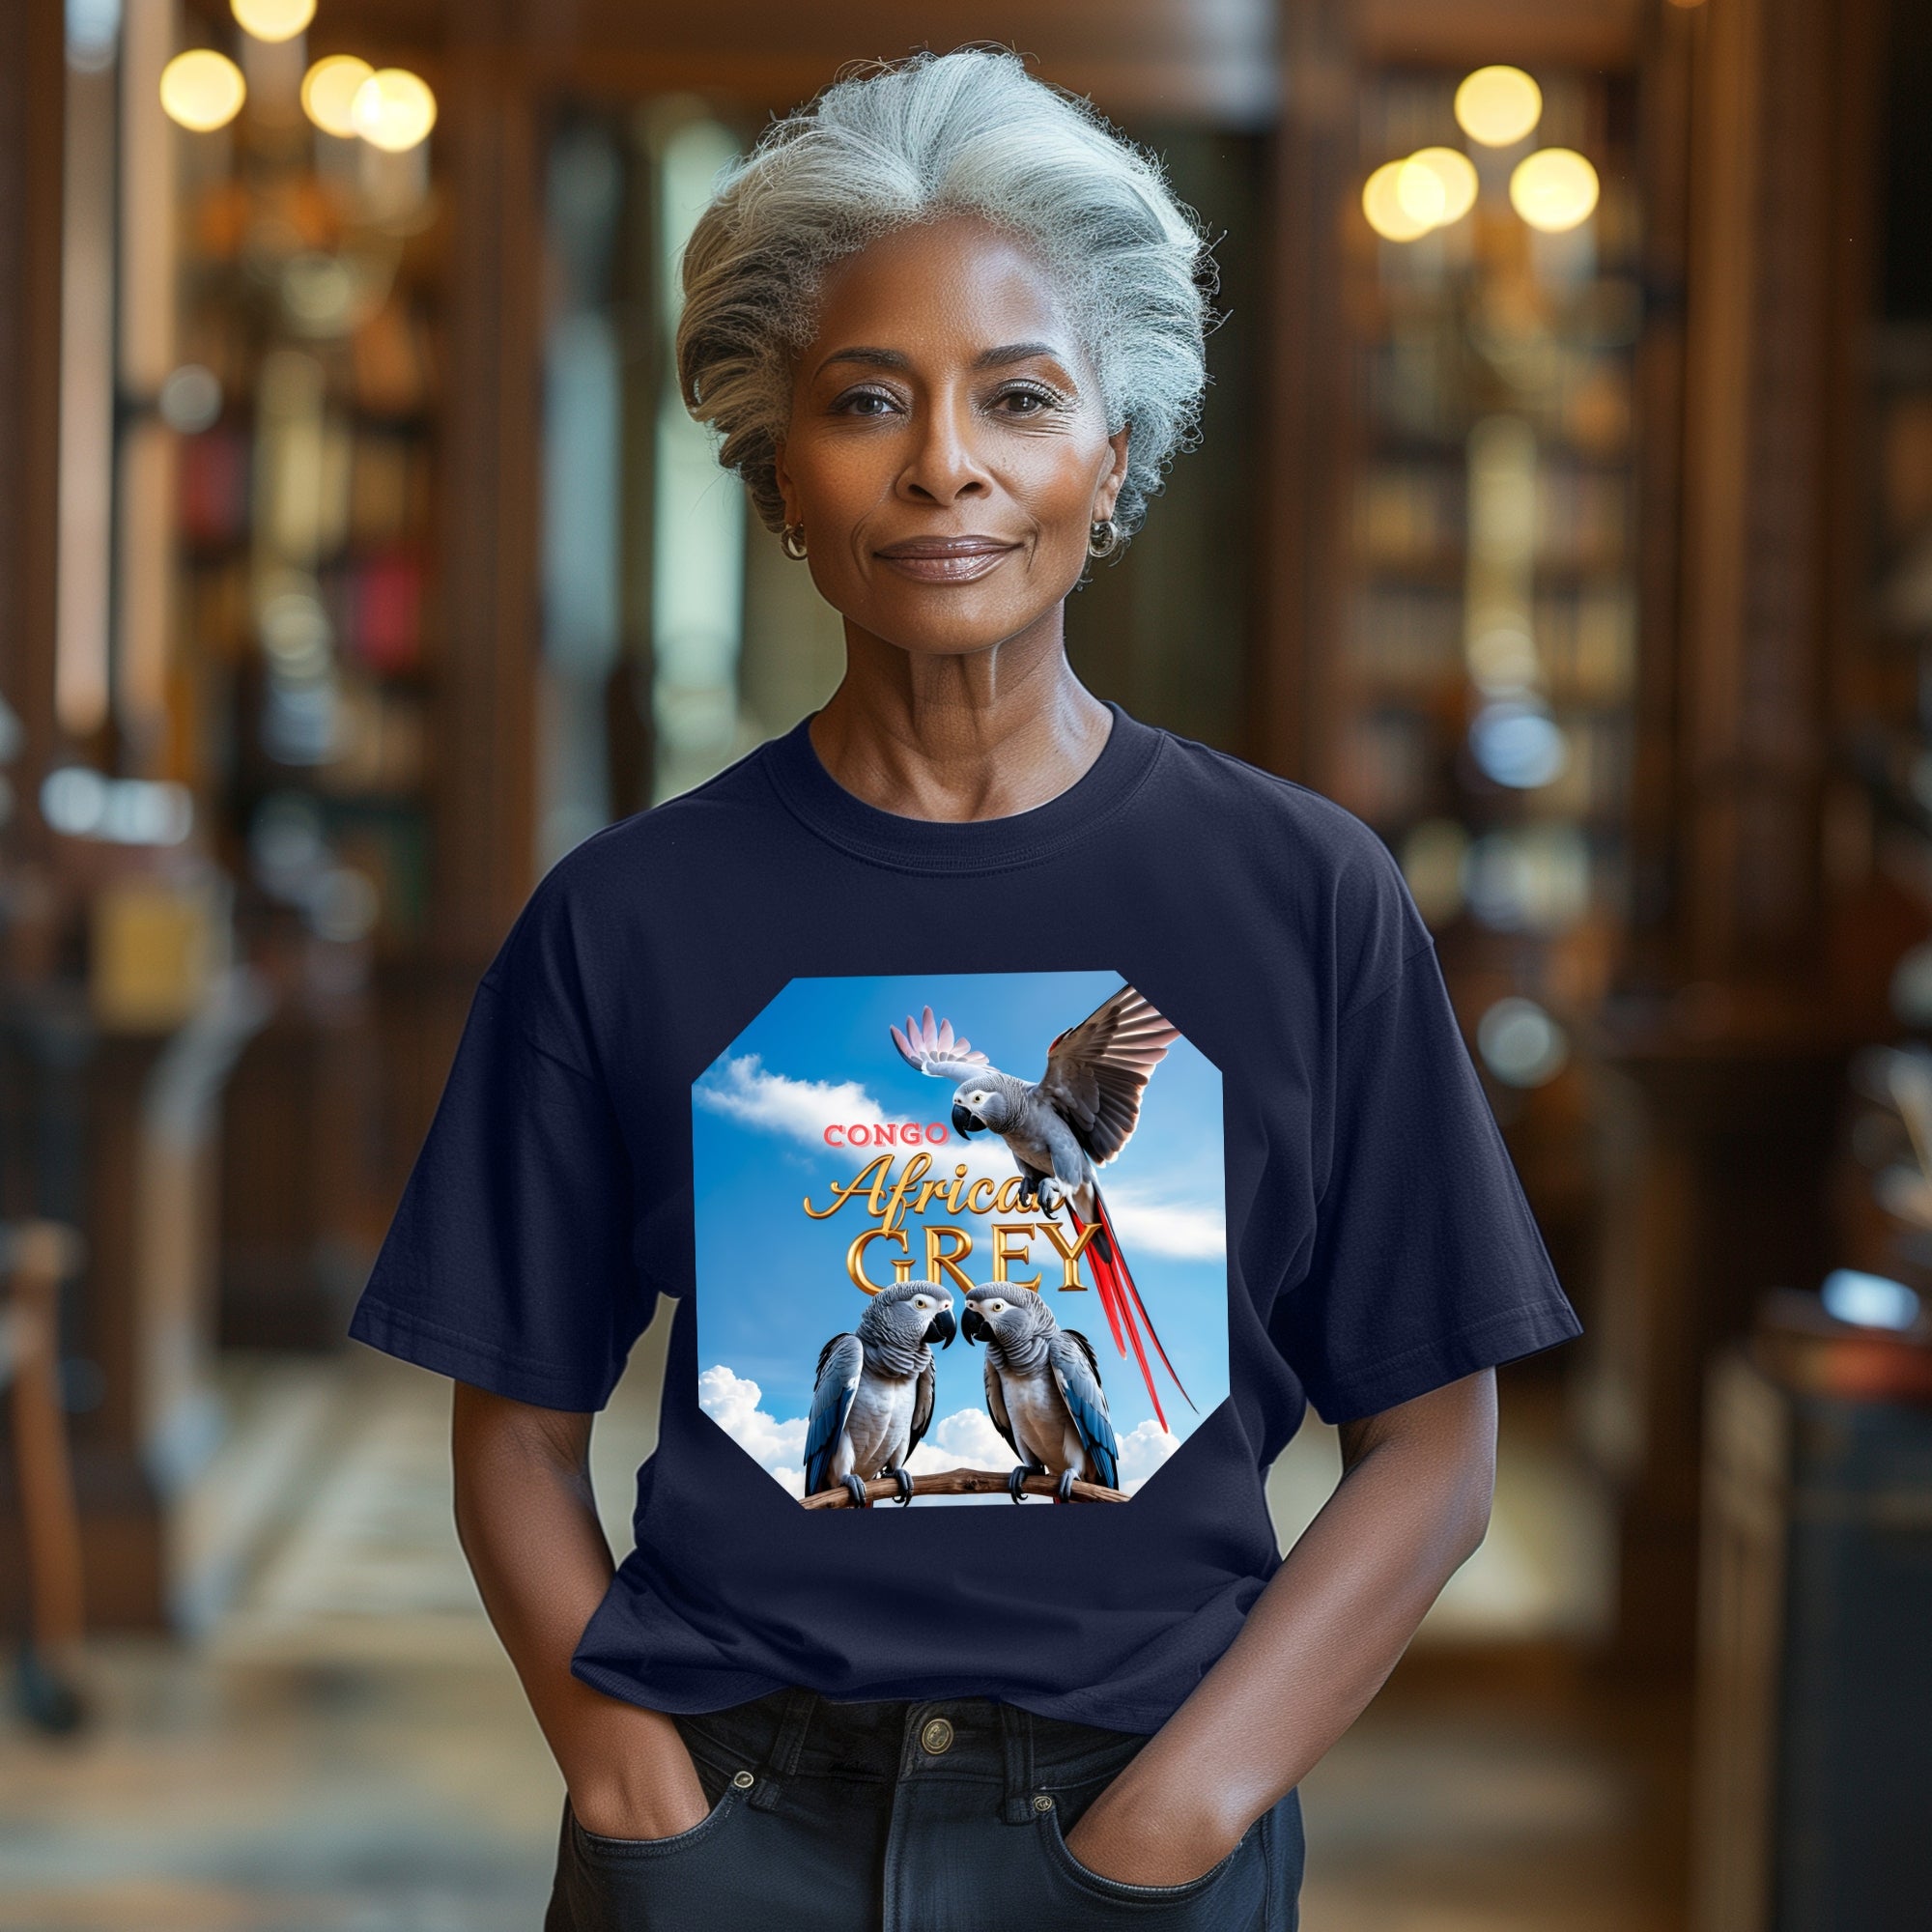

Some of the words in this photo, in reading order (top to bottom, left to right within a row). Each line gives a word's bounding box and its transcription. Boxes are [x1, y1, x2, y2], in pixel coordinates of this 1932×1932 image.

[823, 1122, 950, 1148] CONGO
[803, 1151, 1066, 1236] Africa
[846, 1222, 1103, 1296] GREY
